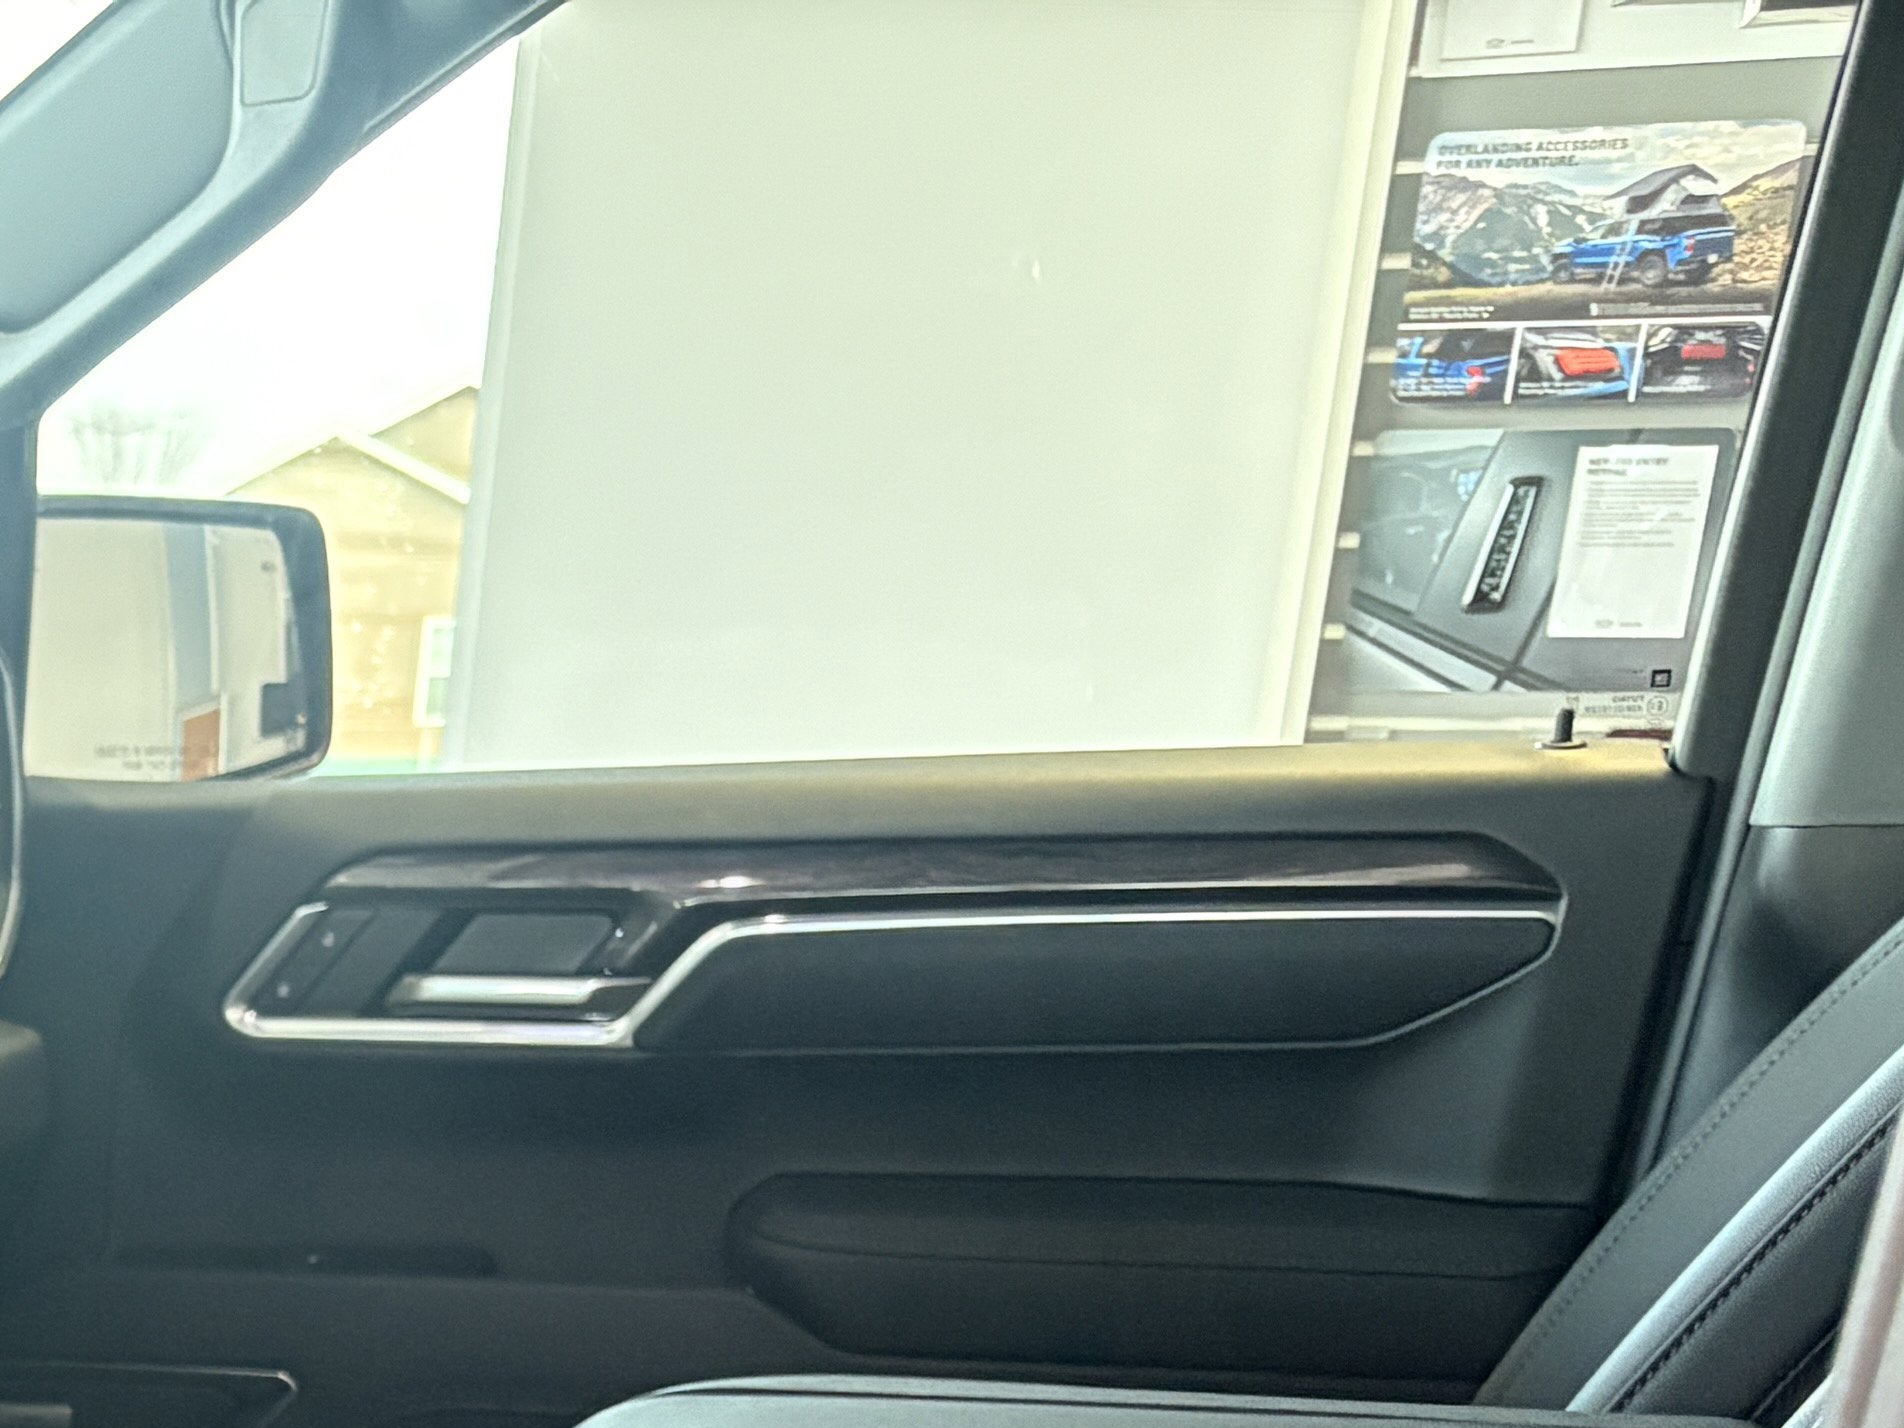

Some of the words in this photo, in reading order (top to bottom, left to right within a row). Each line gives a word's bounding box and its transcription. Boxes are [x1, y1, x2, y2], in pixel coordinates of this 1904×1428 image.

[1437, 142, 1532, 156] OVERLANDING
[1536, 138, 1629, 152] ACCESSORIES
[1437, 160, 1461, 170] FOR
[1466, 158, 1493, 169] ANY
[1495, 155, 1580, 169] ADVENTURE.
